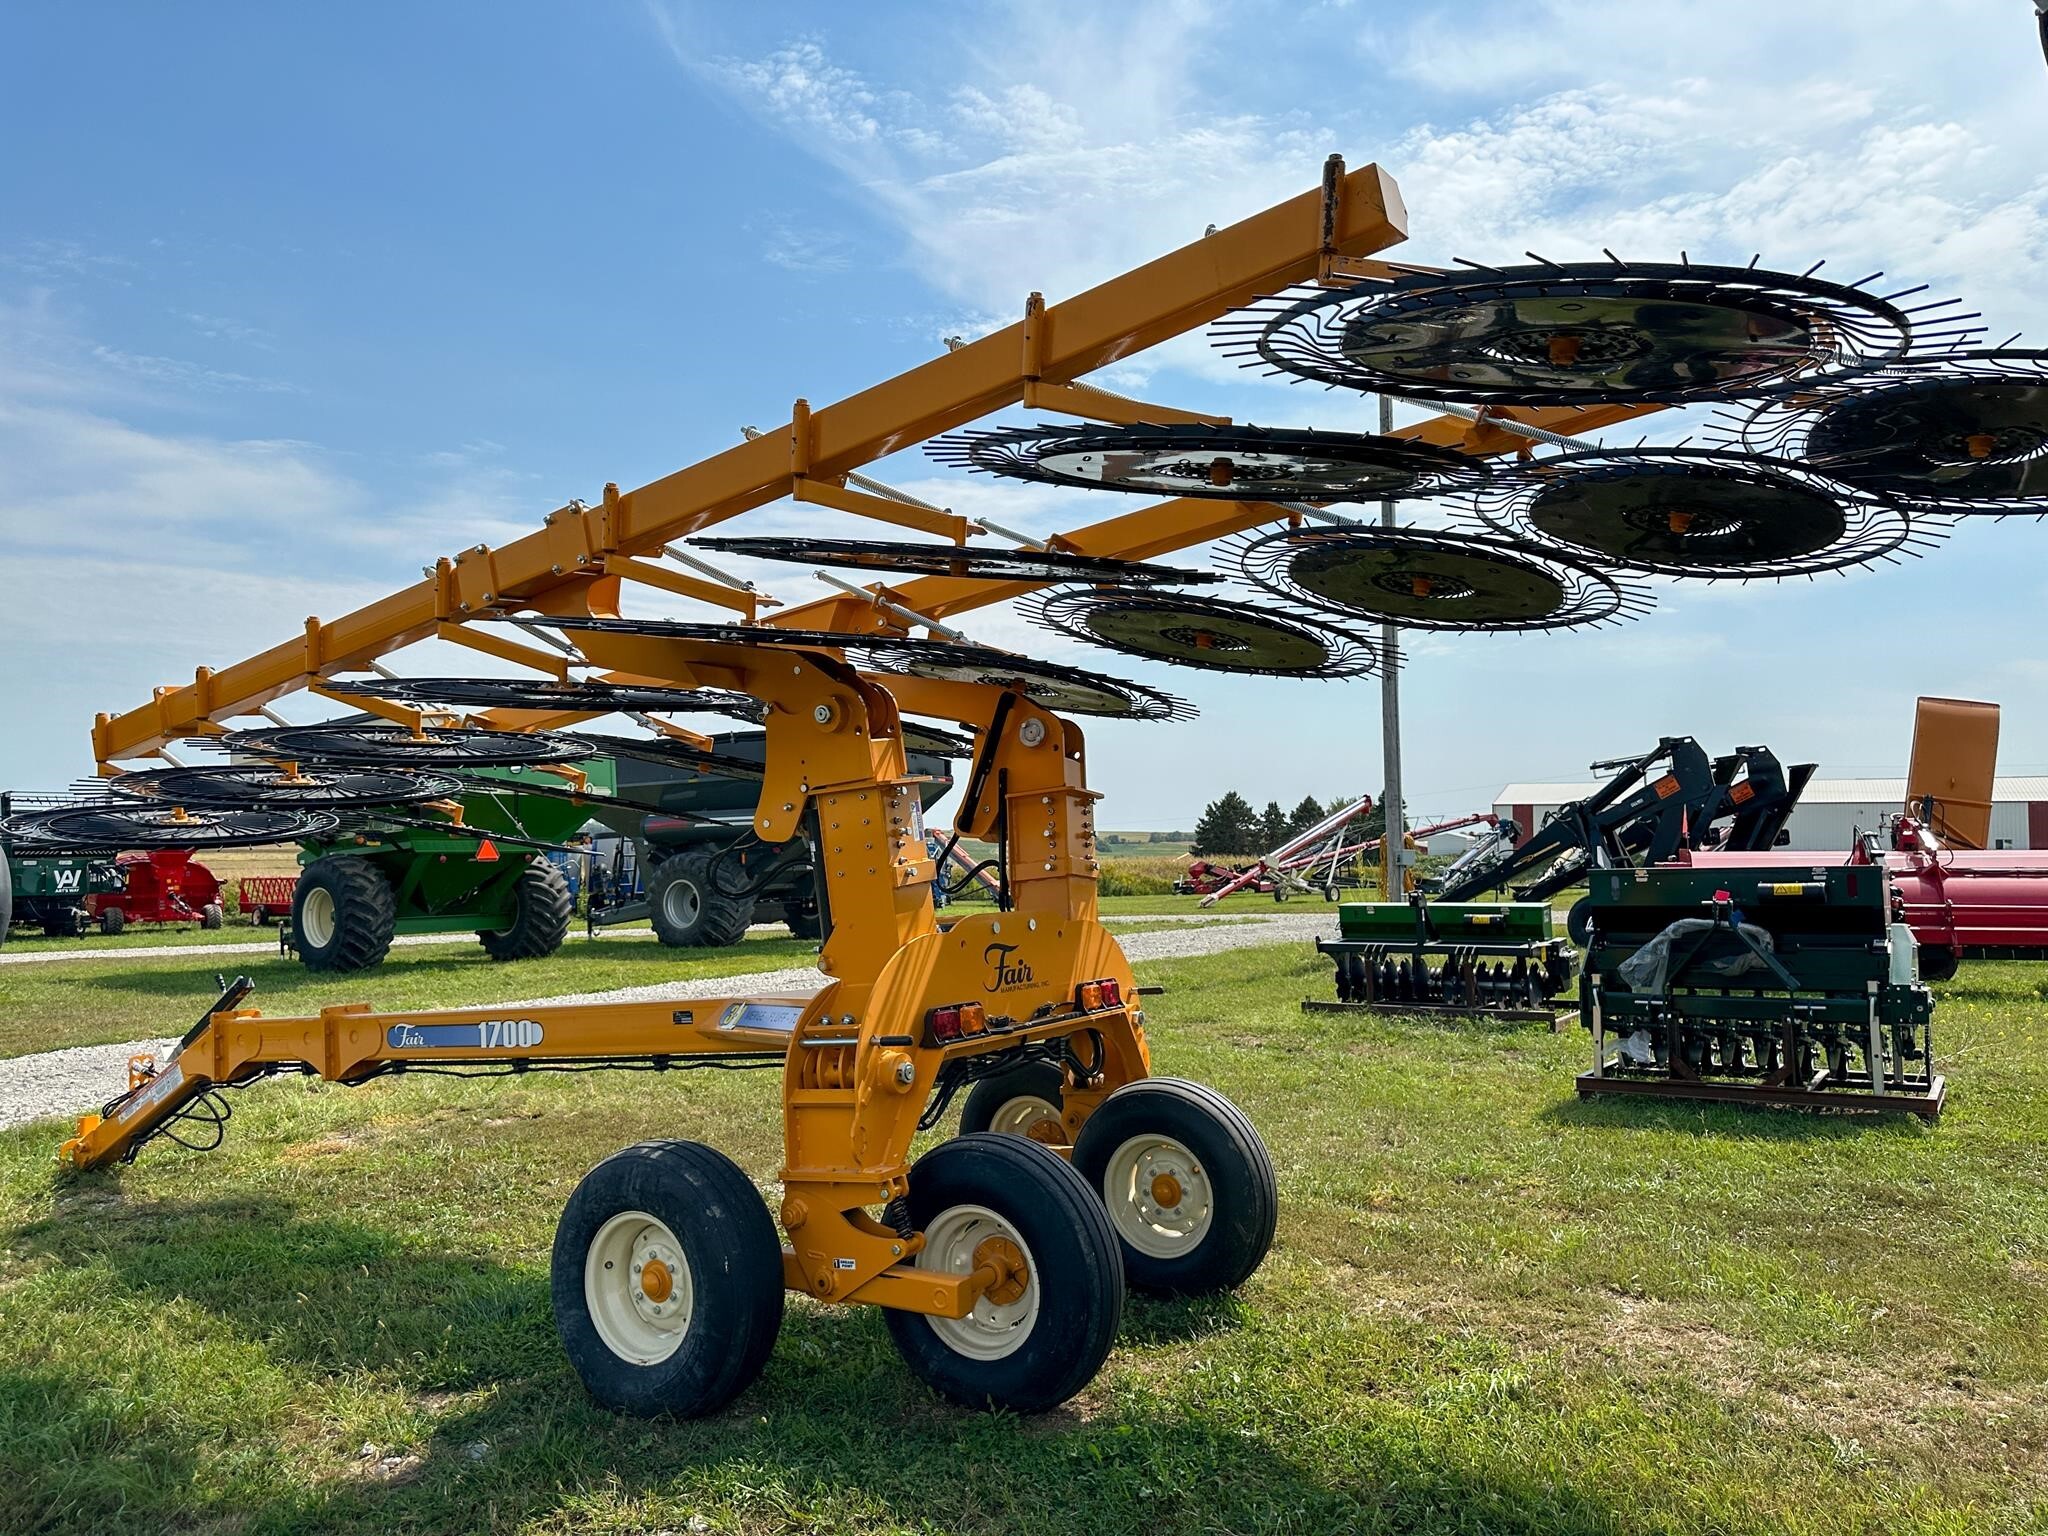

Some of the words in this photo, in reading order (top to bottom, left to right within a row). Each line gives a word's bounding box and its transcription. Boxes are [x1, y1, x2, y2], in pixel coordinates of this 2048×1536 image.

[983, 943, 1034, 993] Fair
[394, 1023, 425, 1048] Fair
[478, 1019, 533, 1049] 1700
